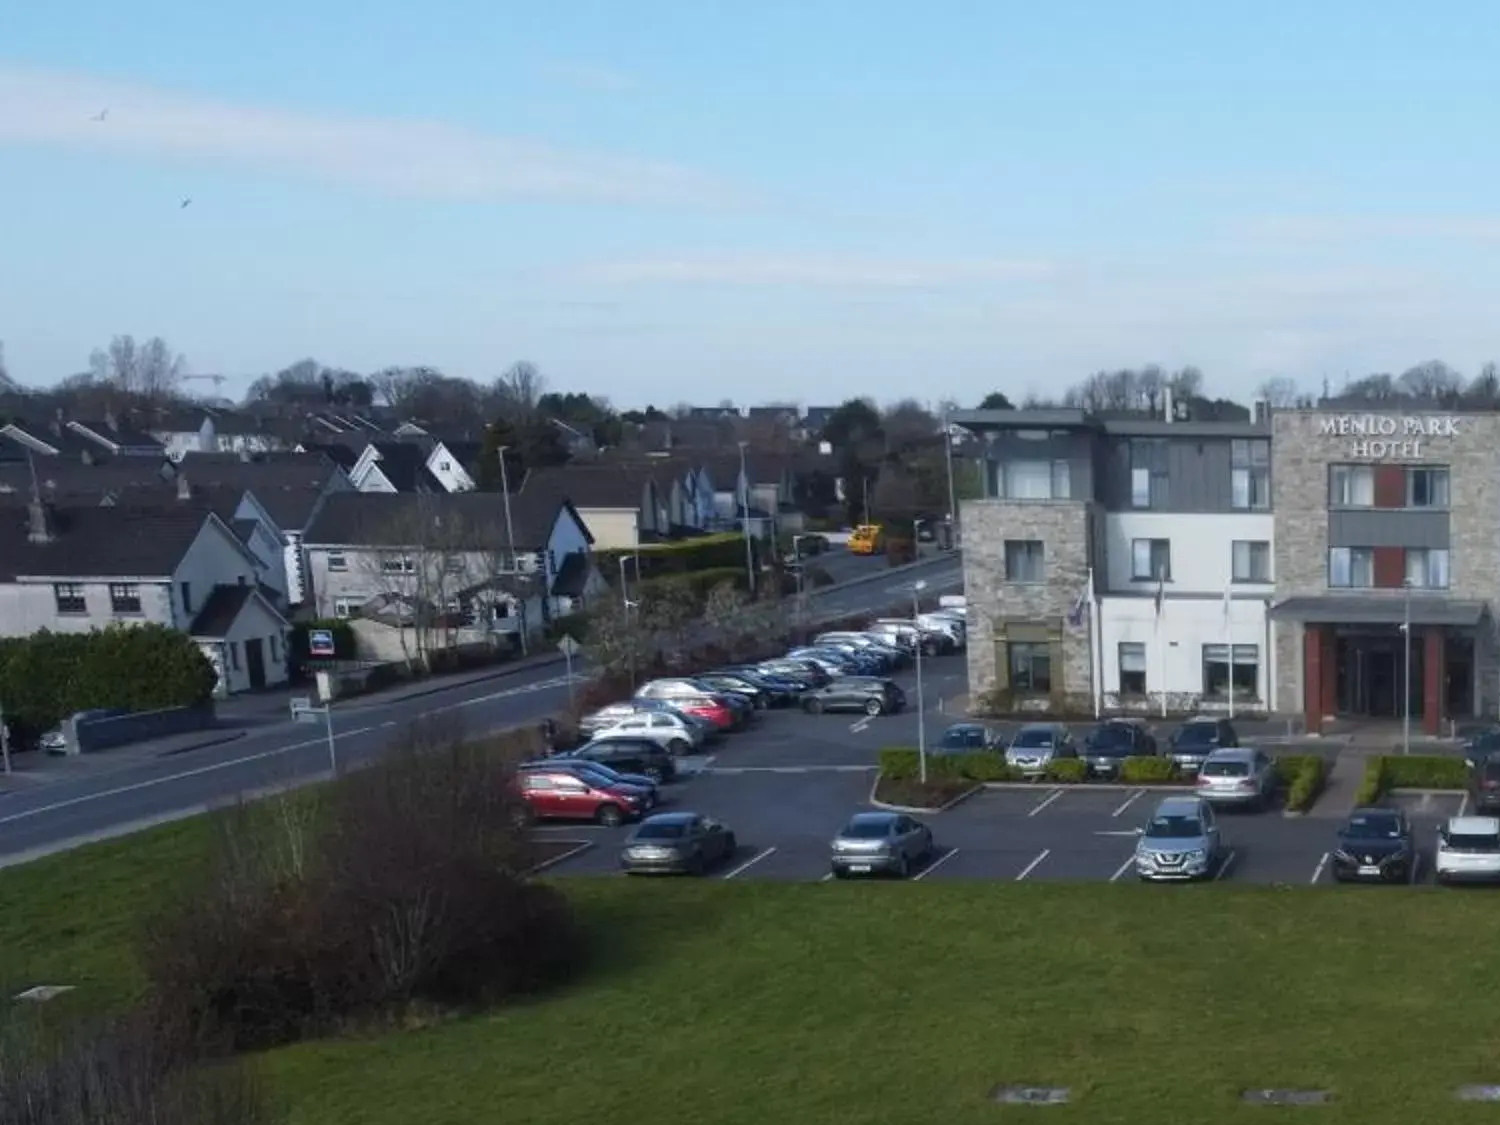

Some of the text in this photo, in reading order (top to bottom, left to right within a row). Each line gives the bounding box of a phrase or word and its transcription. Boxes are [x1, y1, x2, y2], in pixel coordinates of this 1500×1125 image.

[1320, 415, 1461, 435] MENLO PARK
[1352, 440, 1424, 459] HOTEL
